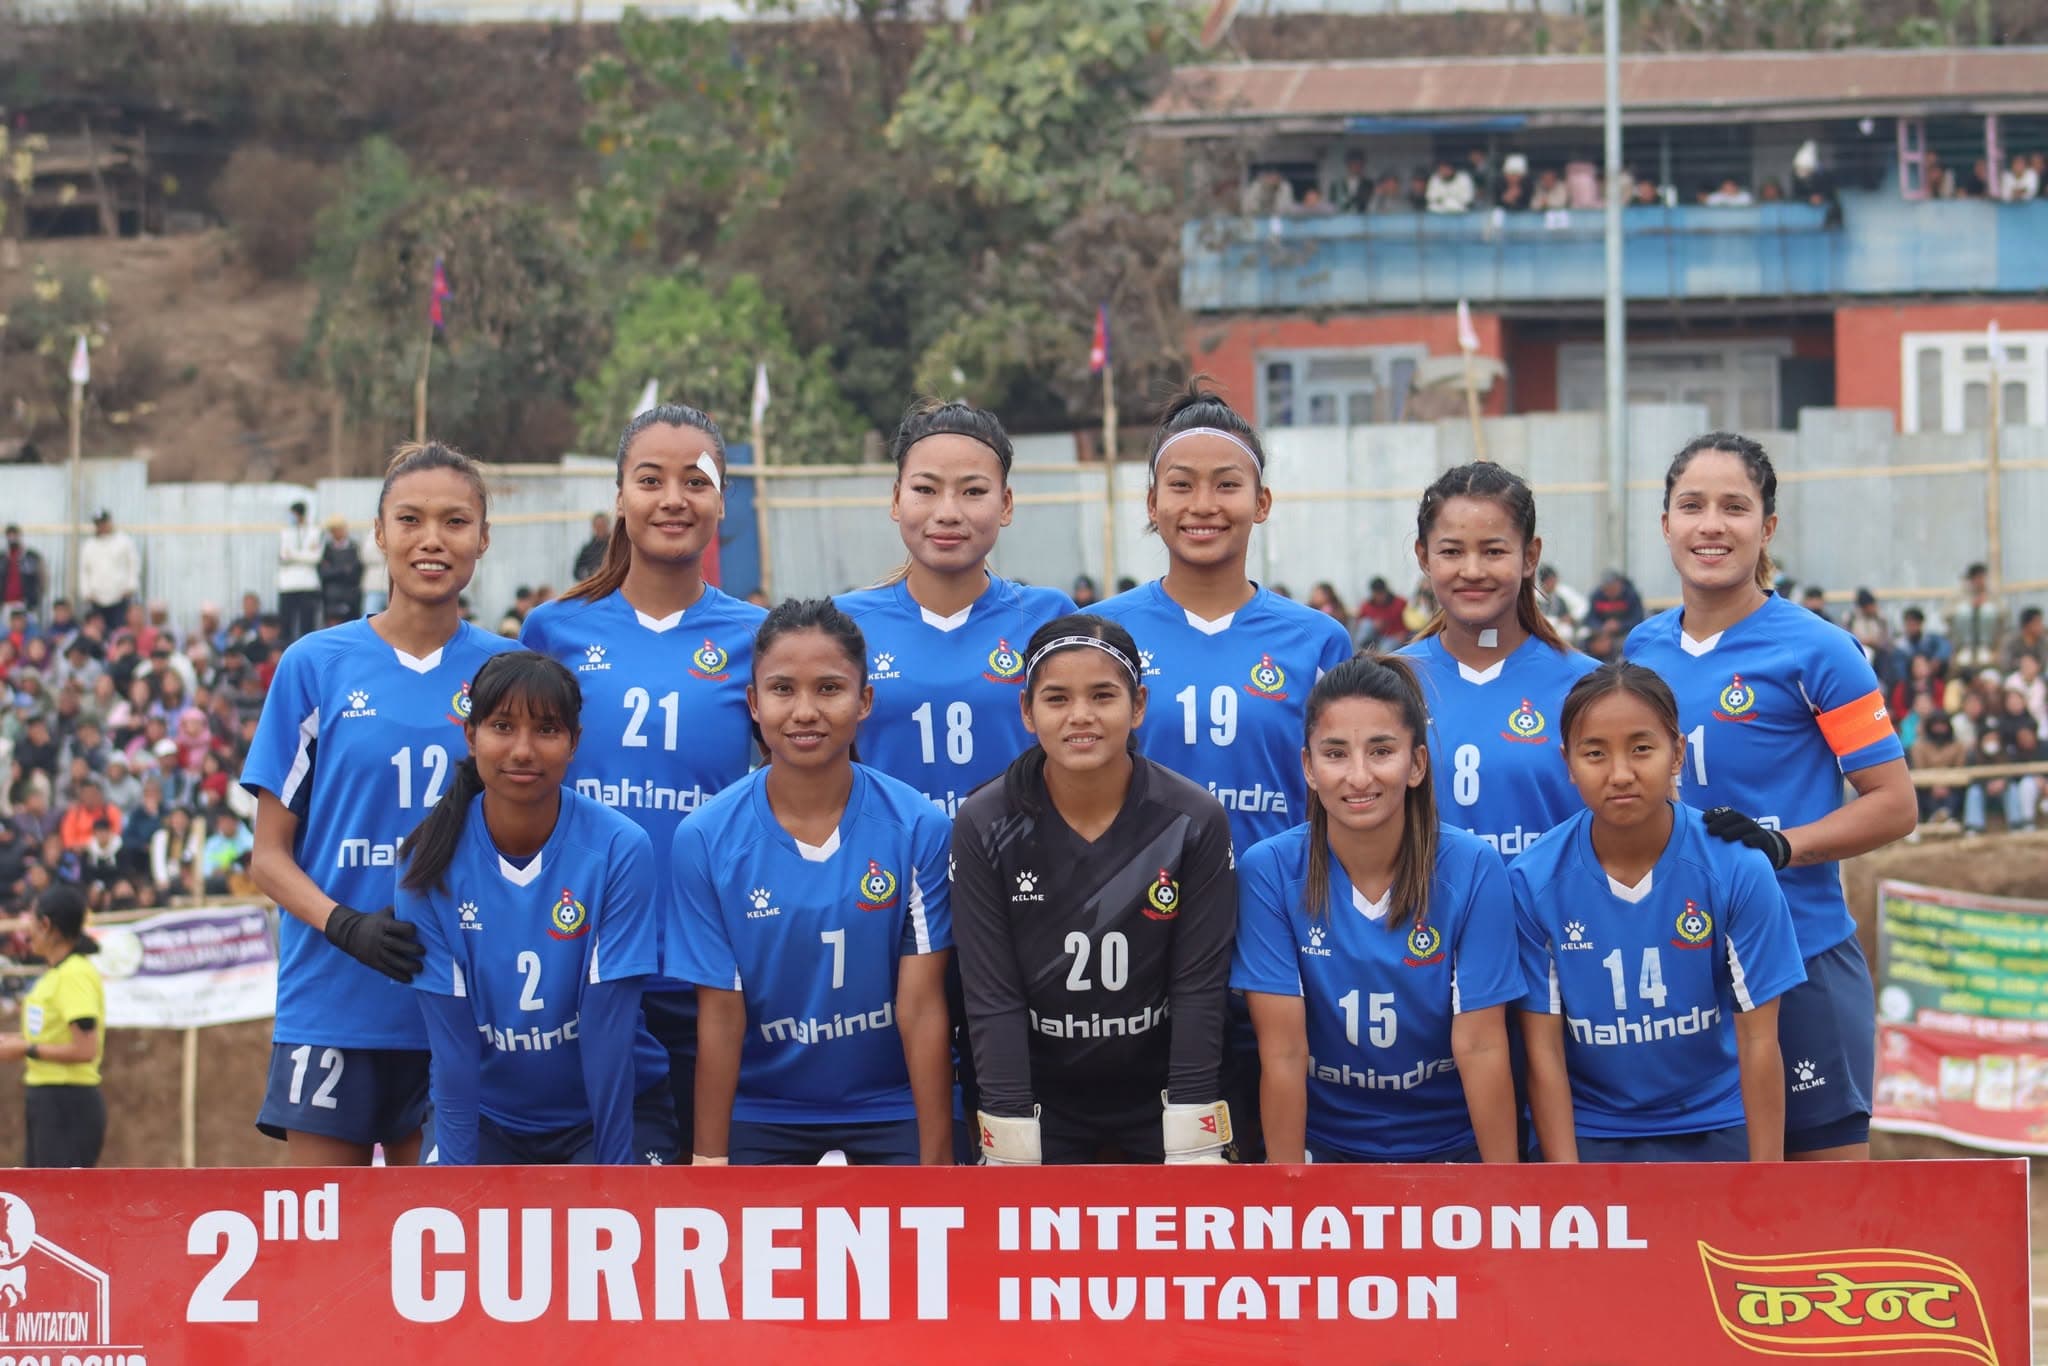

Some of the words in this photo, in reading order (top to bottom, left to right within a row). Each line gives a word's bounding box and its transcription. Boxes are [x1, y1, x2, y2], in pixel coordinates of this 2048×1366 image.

[579, 663, 611, 672] KELME
[868, 671, 900, 681] KELME
[342, 708, 377, 718] KELME
[622, 687, 679, 751] 21
[912, 701, 974, 765] 18
[1176, 685, 1238, 746] 19
[391, 744, 449, 808] 12
[1453, 744, 1481, 806] 8
[747, 907, 781, 919] KELME
[1012, 894, 1044, 902] KELME
[820, 928, 845, 989] 7
[1064, 931, 1129, 991] 20
[1301, 946, 1331, 957] KELME
[1561, 942, 1594, 951] KELME
[517, 951, 545, 1011] 2
[1602, 947, 1667, 1010] 14
[760, 1001, 895, 1045] Mahind
[1338, 989, 1397, 1048] 15
[289, 1044, 345, 1110] 12
[1791, 1077, 1826, 1093] KELME
[998, 1206, 1648, 1250] INTERNATIONAL
[391, 1206, 965, 1323] CURRENT
[16, 1312, 88, 1342] INVITATION
[998, 1276, 1458, 1321] INVITATION
[1735, 1272, 1960, 1329] करेन्ट
